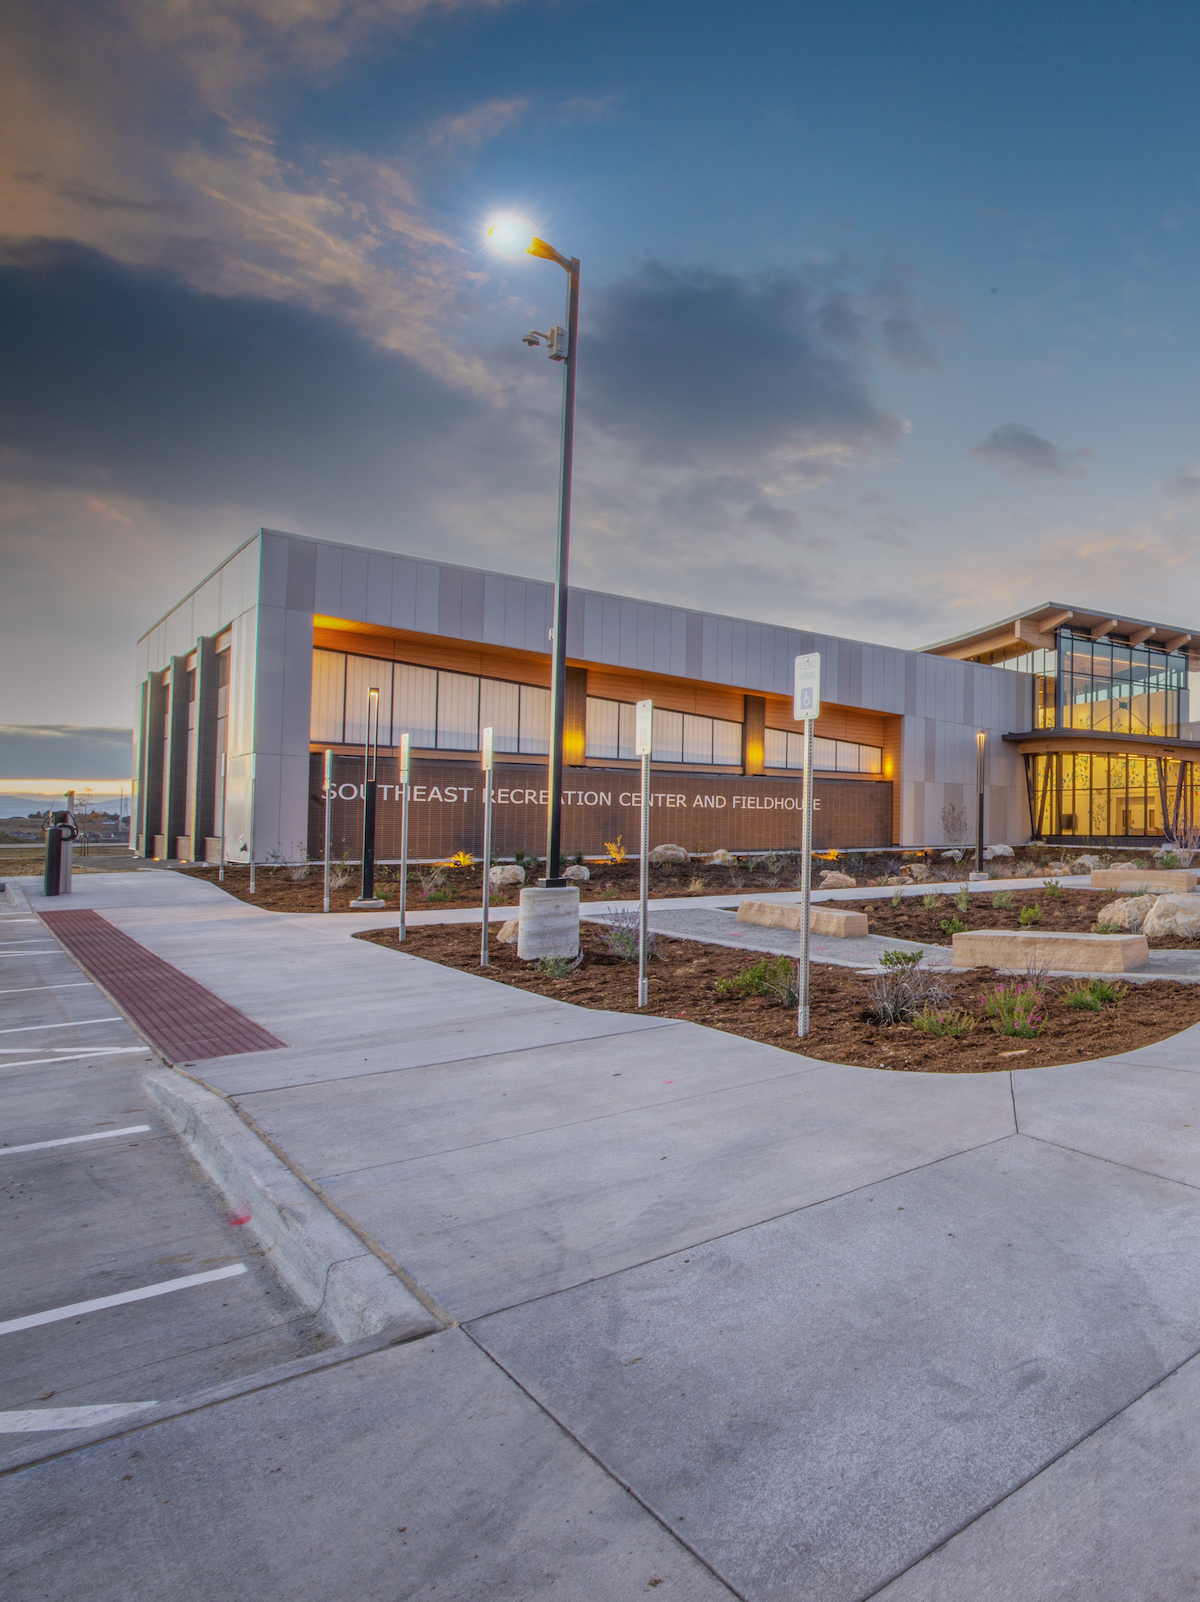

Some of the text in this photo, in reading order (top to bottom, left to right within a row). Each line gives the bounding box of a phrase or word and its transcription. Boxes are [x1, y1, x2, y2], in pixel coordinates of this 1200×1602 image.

[797, 660, 818, 671] RESERVED
[798, 671, 816, 681] PARKING
[482, 788, 611, 806] RECRETION
[692, 795, 727, 808] AND
[732, 795, 821, 811] FIELDHOUE
